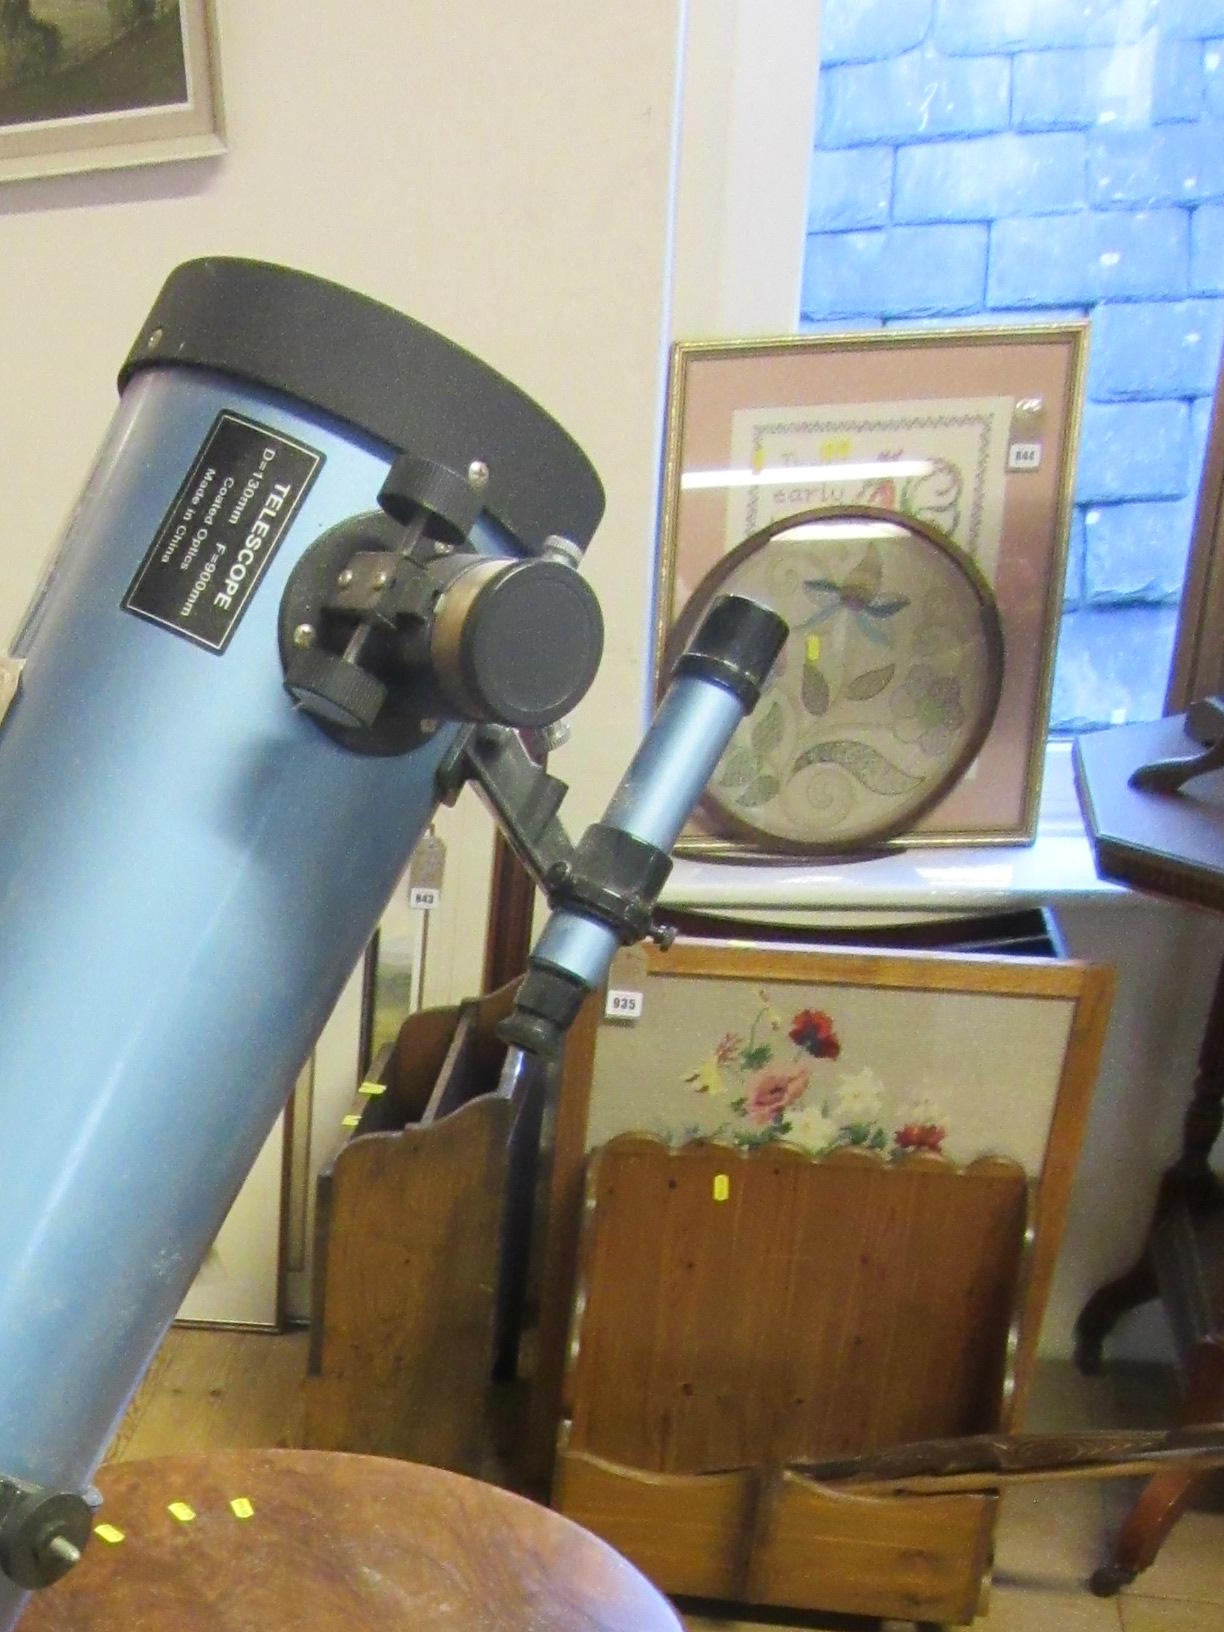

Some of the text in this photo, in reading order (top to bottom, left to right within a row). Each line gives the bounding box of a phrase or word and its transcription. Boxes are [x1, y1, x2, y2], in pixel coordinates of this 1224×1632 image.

[161, 467, 216, 563] Made in China
[180, 476, 234, 571] Coated Optics
[180, 447, 276, 617] D=130mm F=900mm
[213, 483, 291, 610] TELESCOPE
[612, 995, 637, 1011] 935
